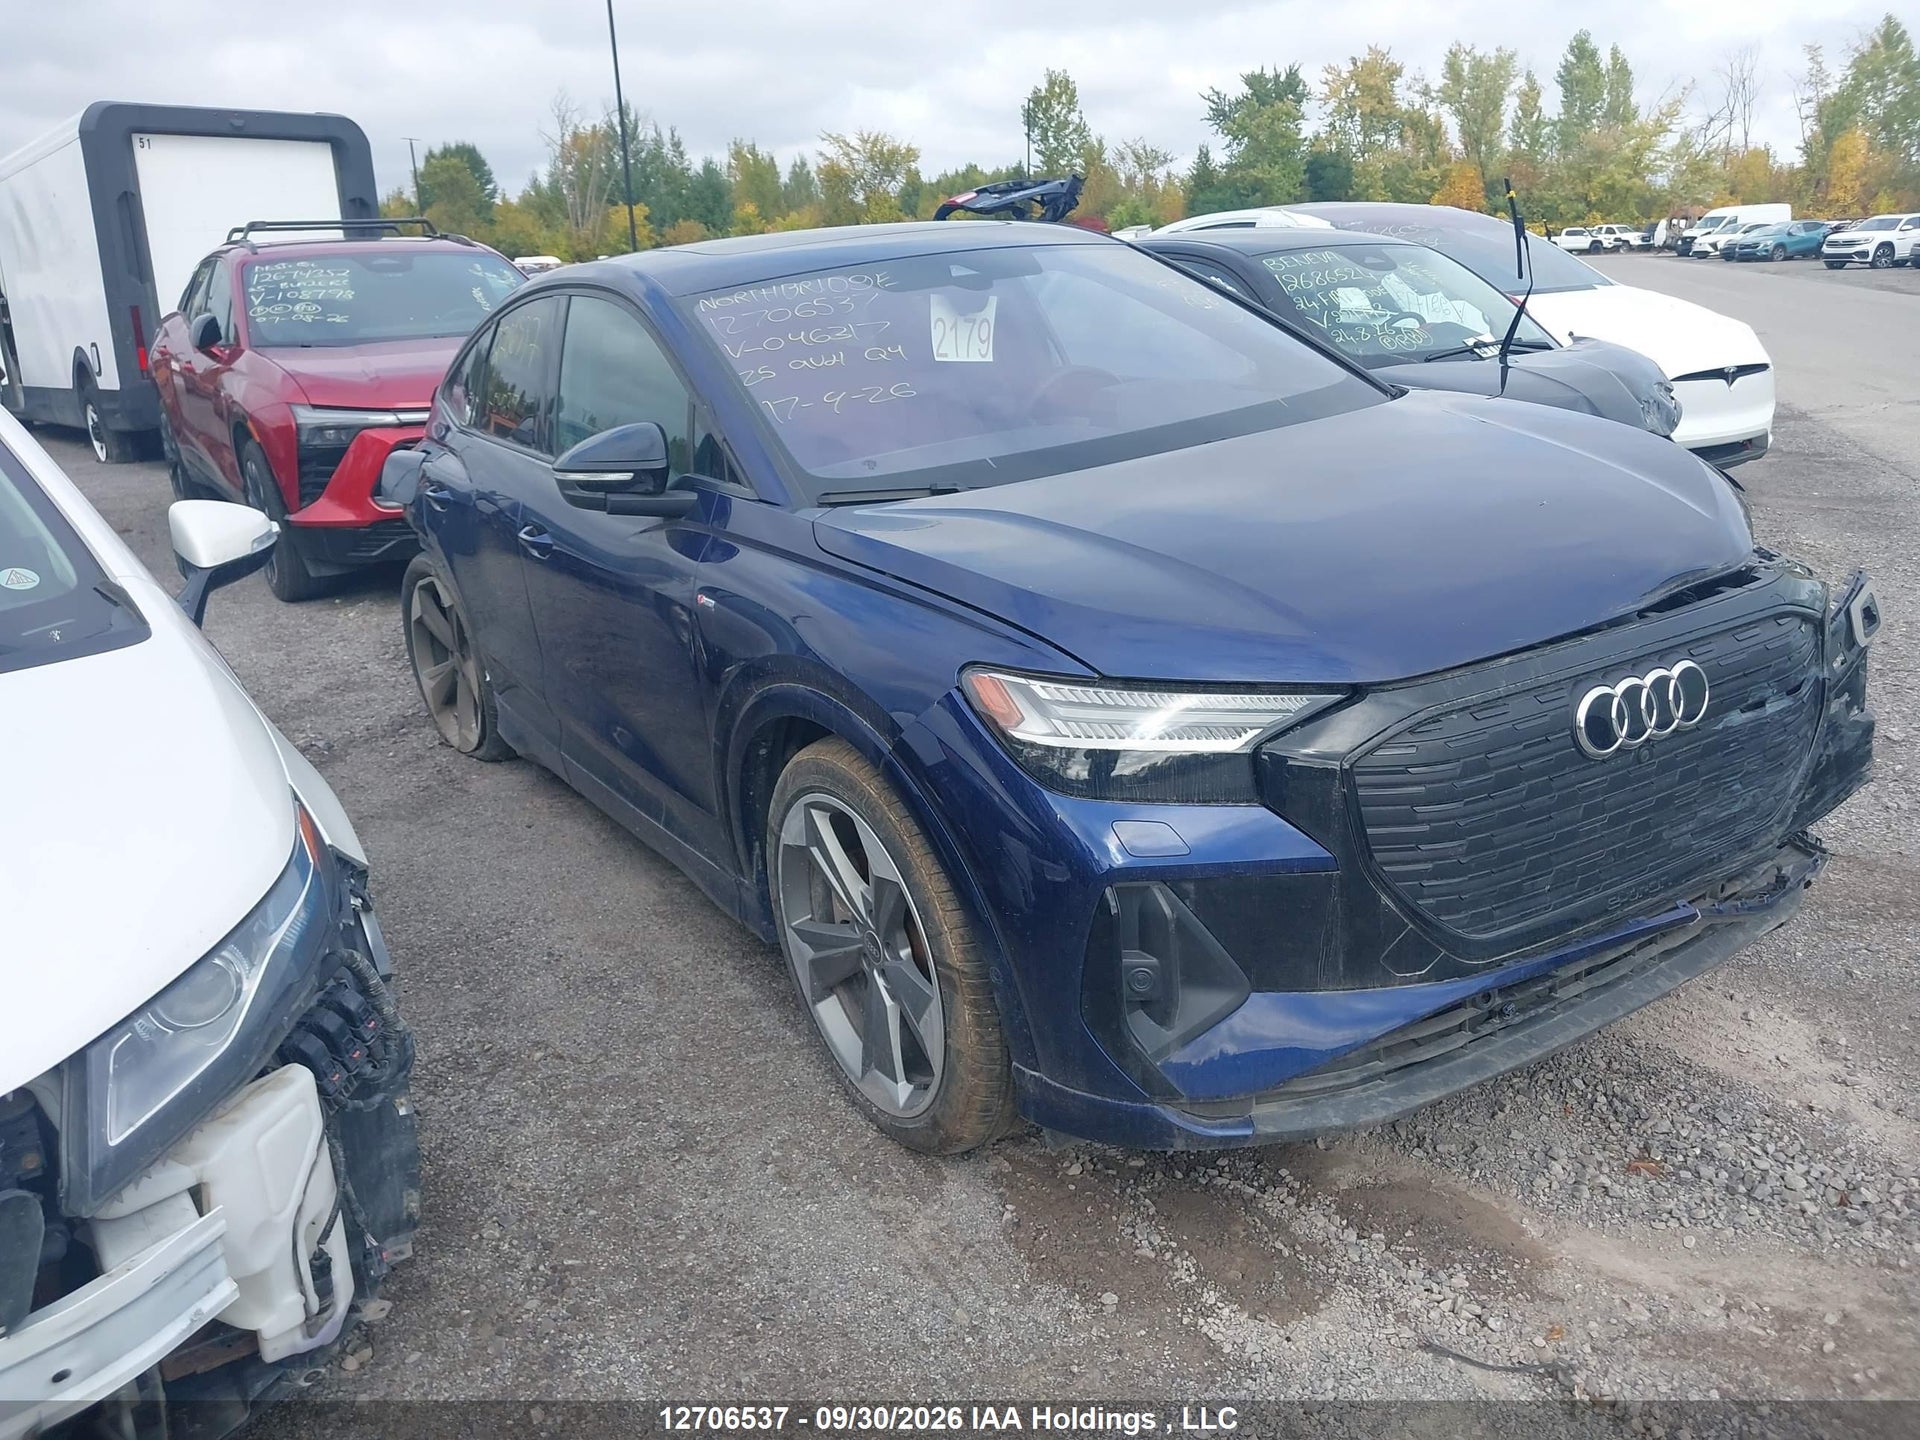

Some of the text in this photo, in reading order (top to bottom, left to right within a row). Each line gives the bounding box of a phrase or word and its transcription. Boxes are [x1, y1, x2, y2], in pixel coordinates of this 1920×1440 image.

[138, 137, 151, 150] 51
[1262, 250, 1342, 271] BENEVA
[1273, 266, 1378, 296] 12686524
[709, 293, 879, 339] 12706537
[933, 317, 992, 359] 2179
[738, 365, 776, 387] 25
[863, 344, 908, 361] Q4
